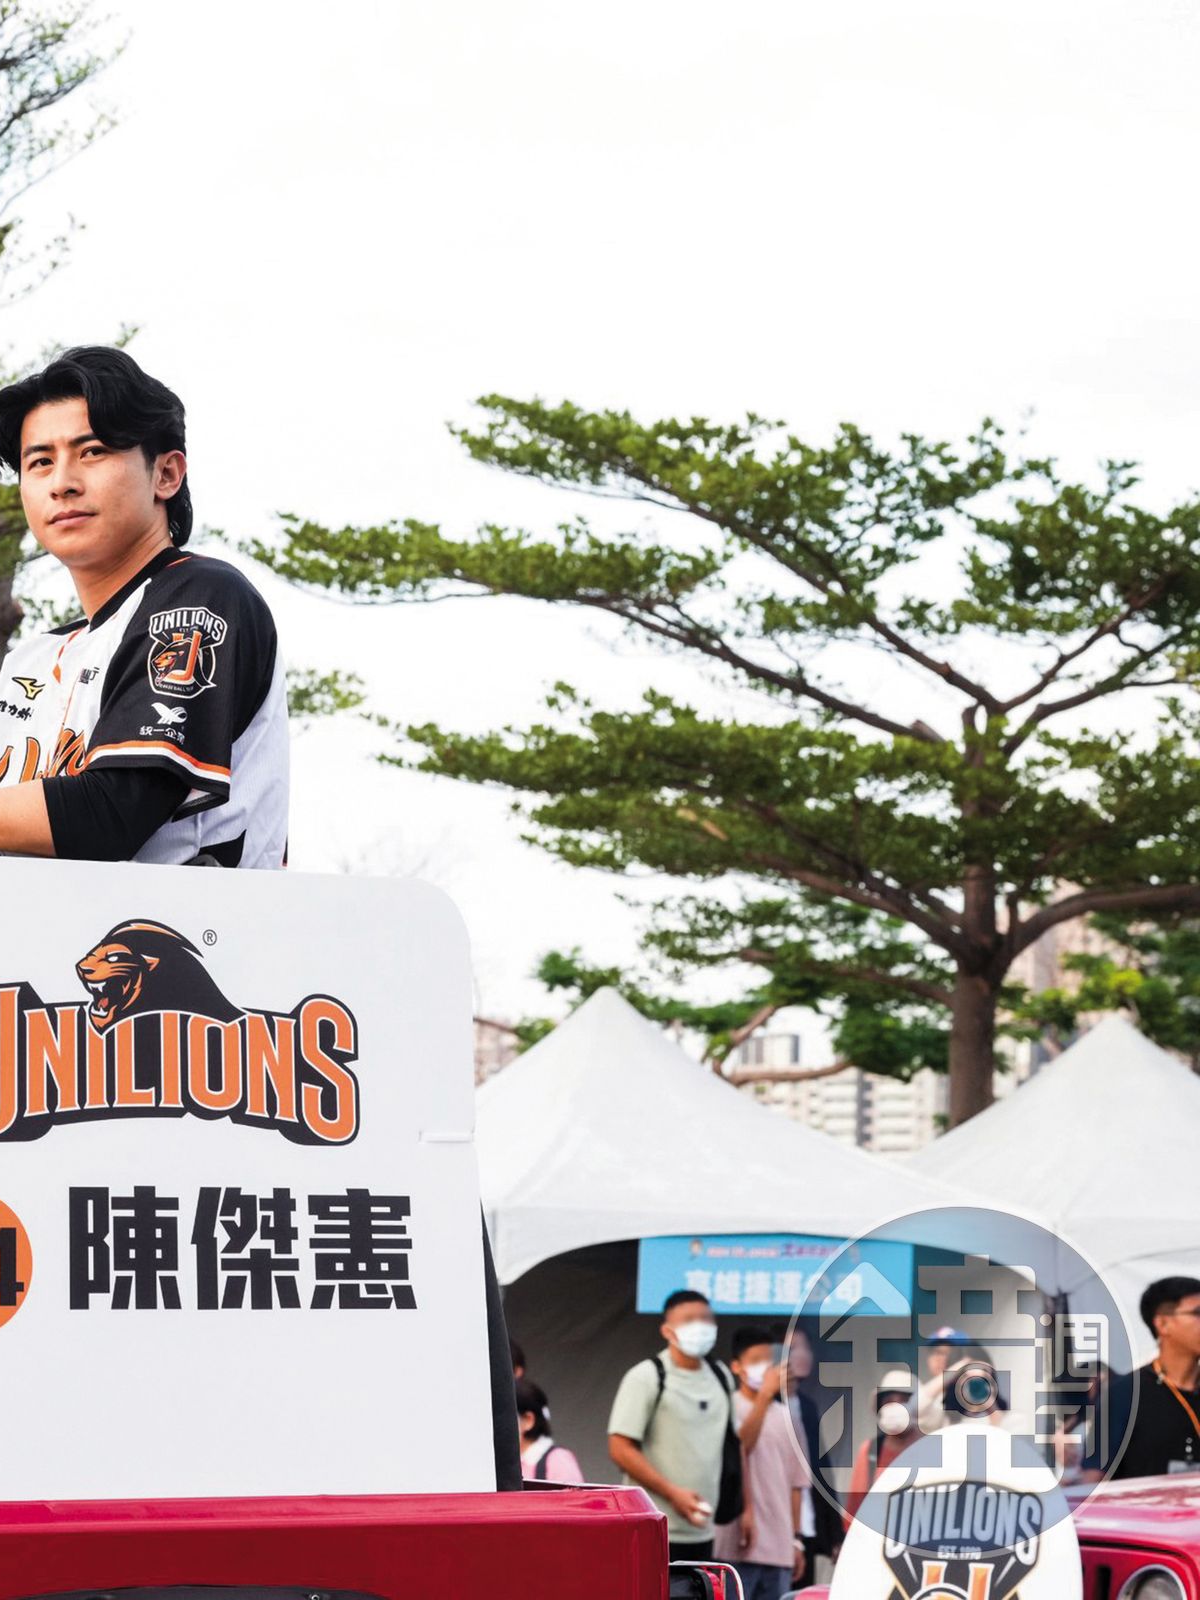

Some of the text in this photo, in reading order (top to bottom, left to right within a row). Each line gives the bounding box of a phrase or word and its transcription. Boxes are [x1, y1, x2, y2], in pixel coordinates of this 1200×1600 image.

[152, 609, 224, 642] UNILIONS
[68, 1185, 418, 1310] 陳傑憲
[884, 1483, 1041, 1566] UNILIONS
